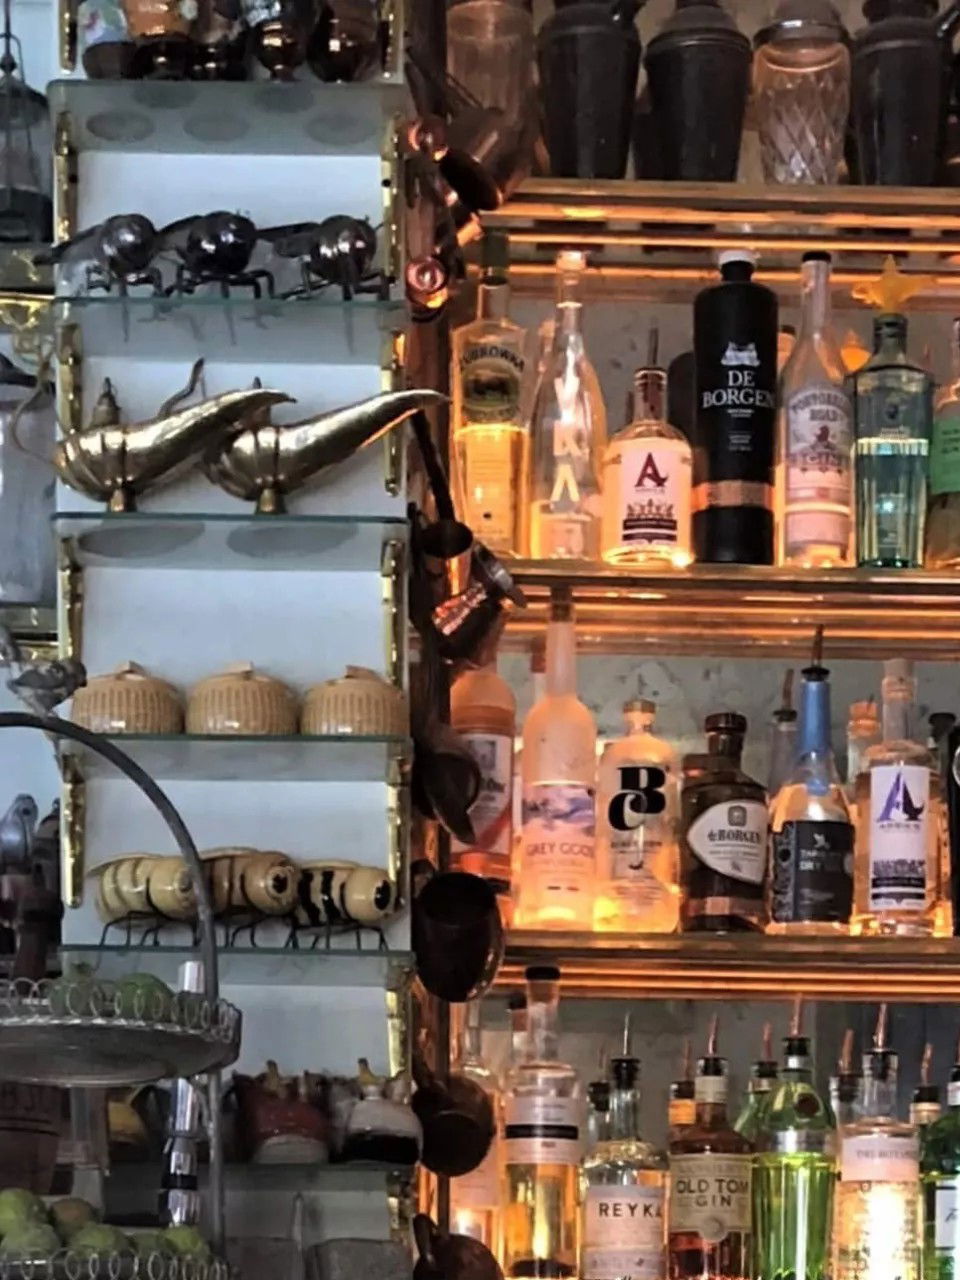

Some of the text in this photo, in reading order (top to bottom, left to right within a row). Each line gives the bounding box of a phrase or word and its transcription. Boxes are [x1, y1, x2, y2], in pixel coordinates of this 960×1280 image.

[727, 370, 755, 387] DE
[676, 1178, 749, 1194] OLD TOM
[696, 1194, 732, 1207] GIN
